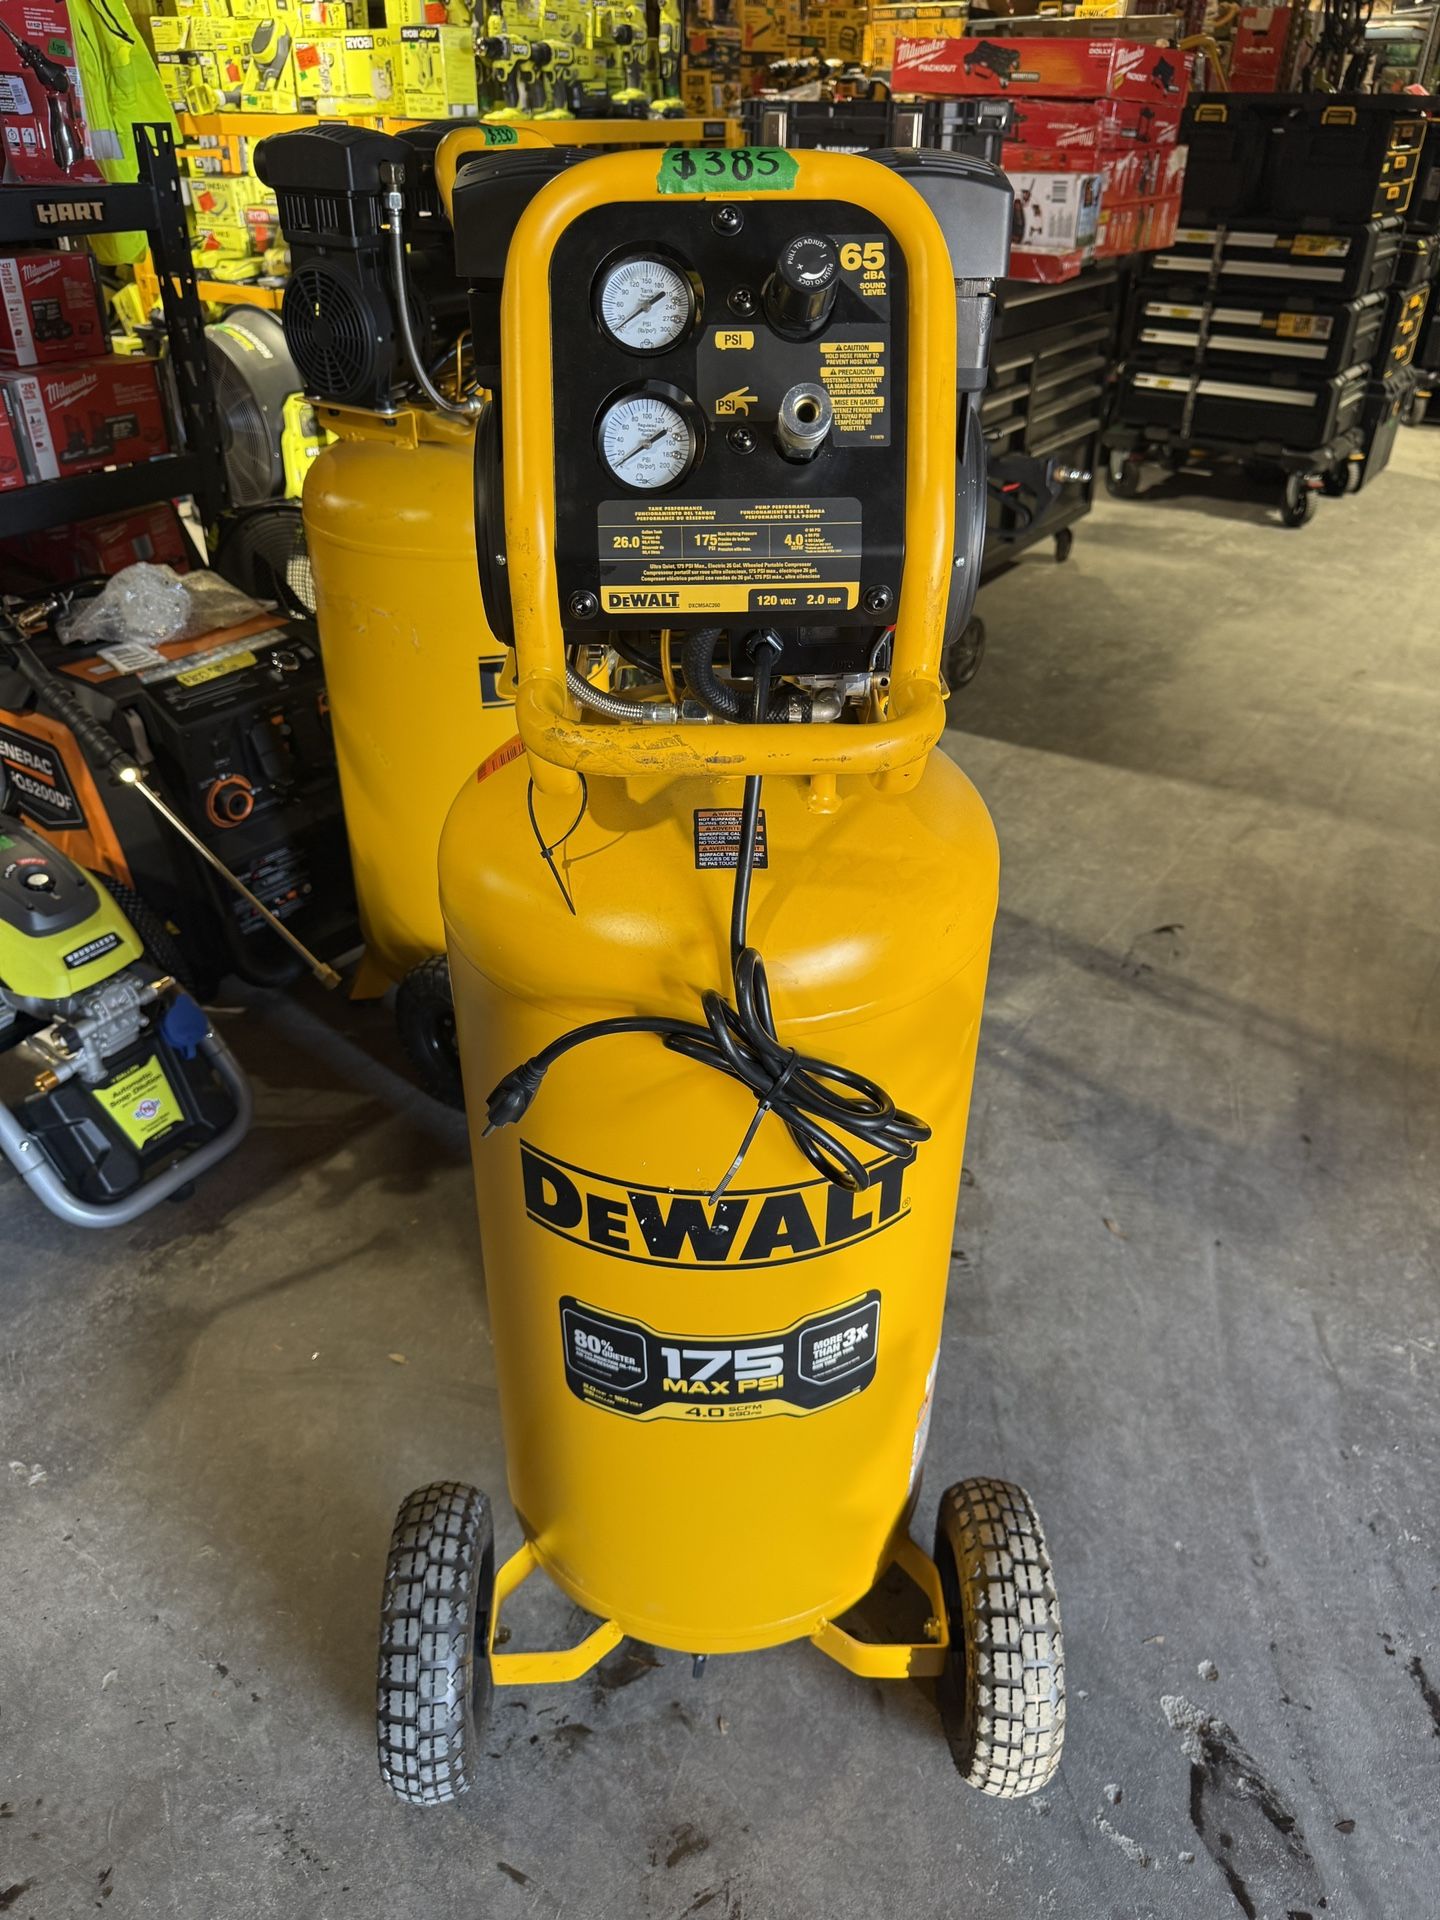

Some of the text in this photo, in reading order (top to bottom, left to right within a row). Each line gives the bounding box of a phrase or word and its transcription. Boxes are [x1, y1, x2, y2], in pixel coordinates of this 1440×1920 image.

[346, 37, 373, 49] RYOBI
[898, 40, 946, 63] Milwaukee
[918, 64, 956, 73] PACKOUT
[673, 150, 779, 181] $385
[36, 201, 104, 223] HART
[787, 238, 827, 265] PULL TO ADJUST
[840, 242, 886, 271] 65
[798, 263, 834, 286] PUSH TO LOCK
[863, 270, 886, 280] dBA
[859, 282, 886, 290] SOUND
[724, 334, 743, 346] PSI
[46, 372, 98, 403] Milwaukee
[718, 399, 736, 411] PSI
[613, 536, 640, 548] 26.0
[694, 534, 718, 546] 175
[784, 534, 804, 546] 4.0
[757, 595, 778, 606] 120
[806, 594, 825, 605] 2.0
[827, 597, 842, 605] RHP
[0, 739, 53, 776] ENERAC
[112, 1071, 153, 1098] Automatic
[573, 1328, 614, 1354] 80%
[813, 1322, 869, 1351] MORE 3X
[602, 1349, 636, 1366] QUIETER
[812, 1342, 841, 1360] THAN
[661, 1343, 784, 1381] 175
[662, 1374, 784, 1395] MAX PSI
[685, 1406, 724, 1417] 4.0
